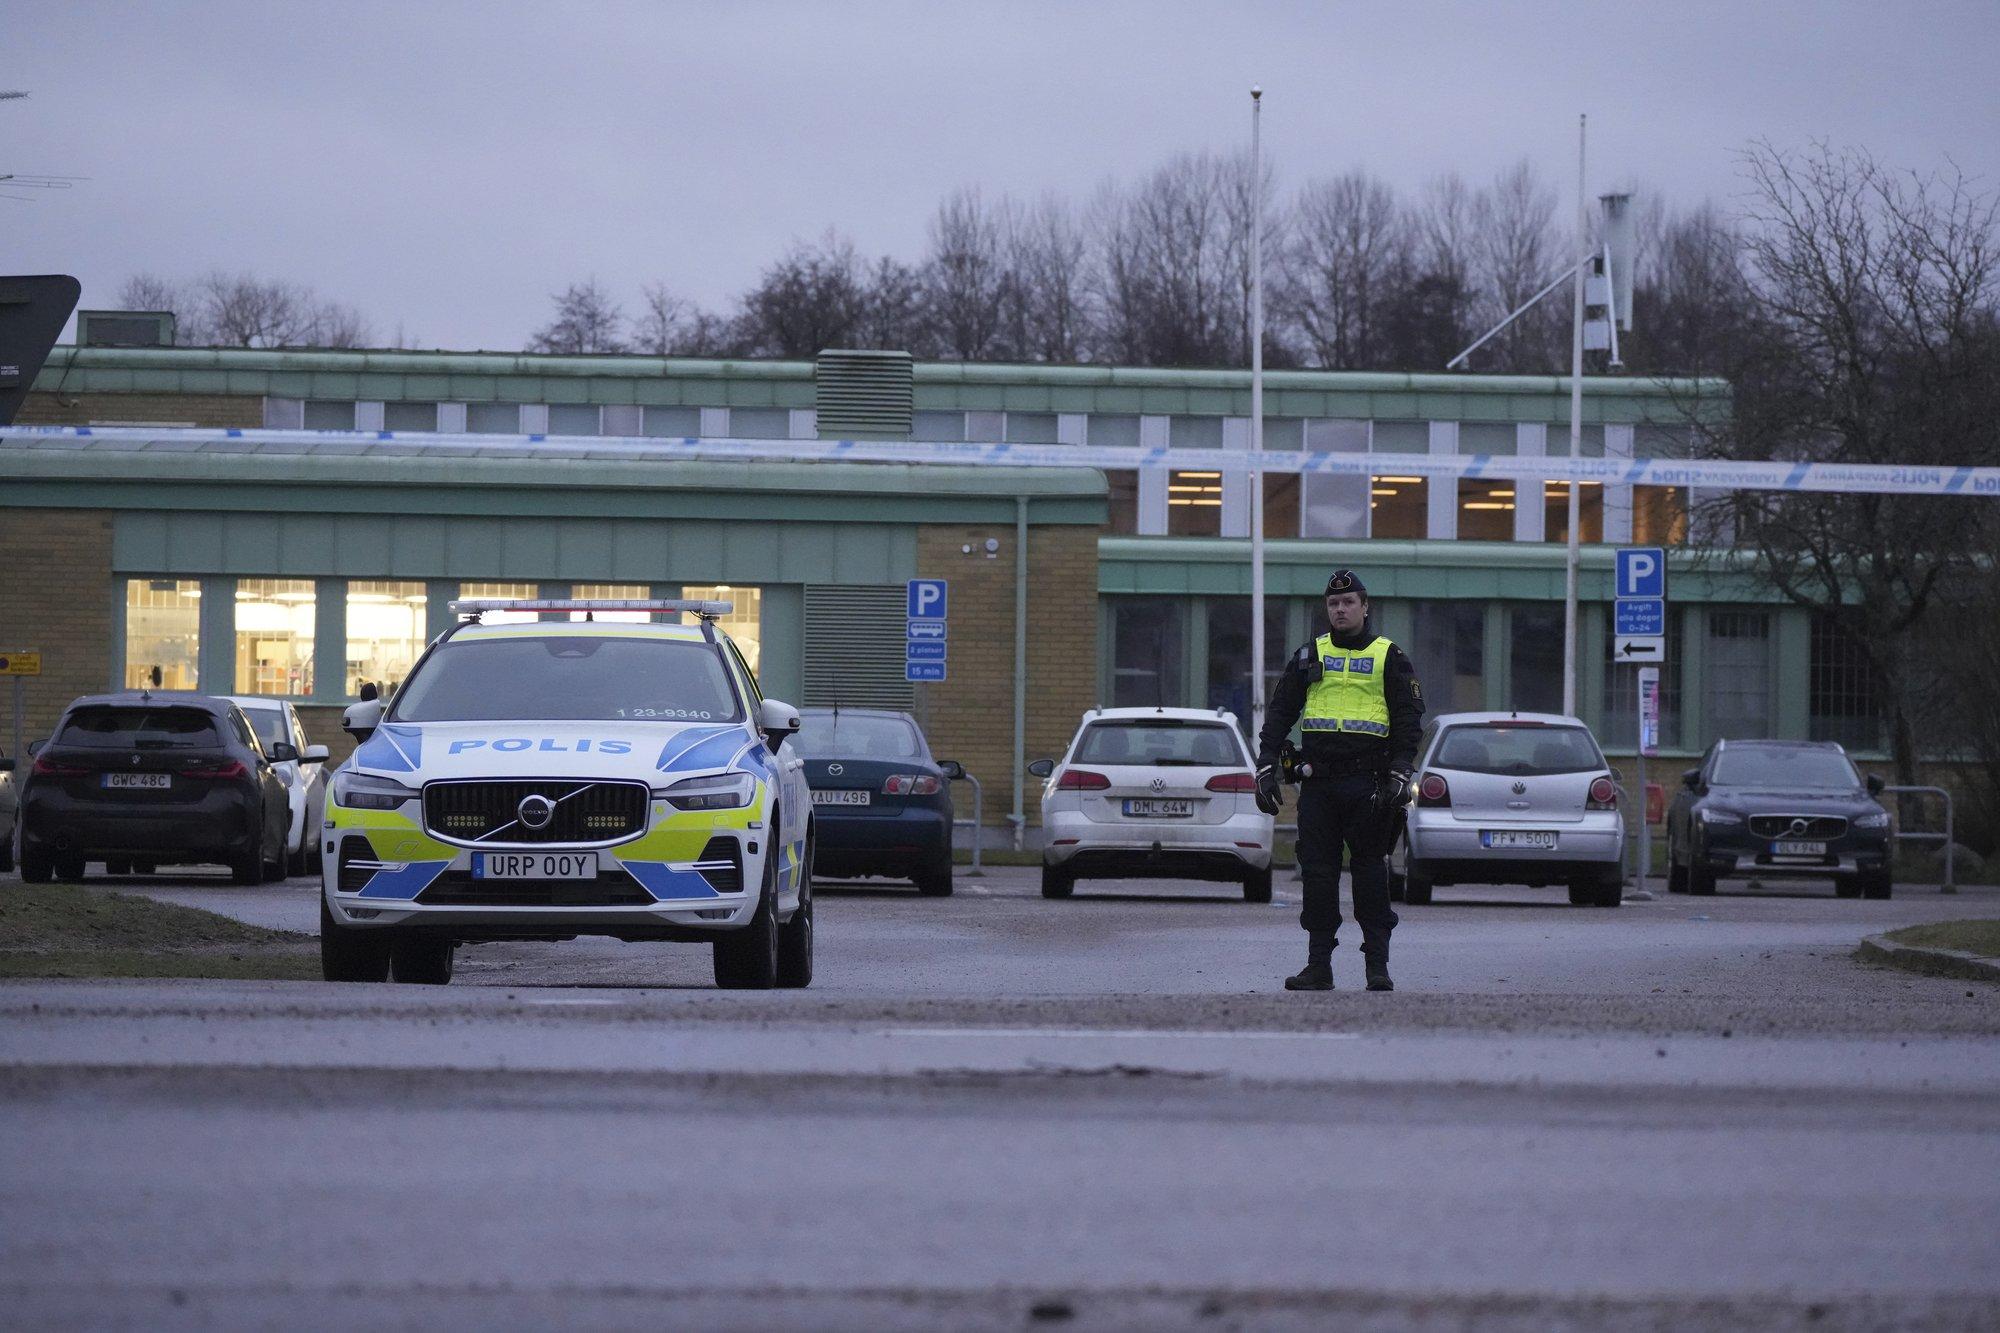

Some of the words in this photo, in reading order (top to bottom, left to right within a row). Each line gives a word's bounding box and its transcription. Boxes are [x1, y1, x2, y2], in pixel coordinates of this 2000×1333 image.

[1628, 554, 1655, 593] P
[917, 583, 940, 616] P
[912, 666, 921, 675] 15
[923, 666, 940, 675] min
[1324, 656, 1372, 672] POLIS
[633, 708, 711, 720] 23-9340
[448, 738, 632, 755] POLIS
[112, 774, 137, 786] GWC
[141, 775, 166, 787] 48C
[843, 792, 867, 804] 496
[1134, 800, 1158, 813] DML
[1162, 801, 1187, 813] 64W
[1492, 831, 1516, 844] FFW
[1526, 832, 1550, 845] 500
[492, 856, 535, 876] URP
